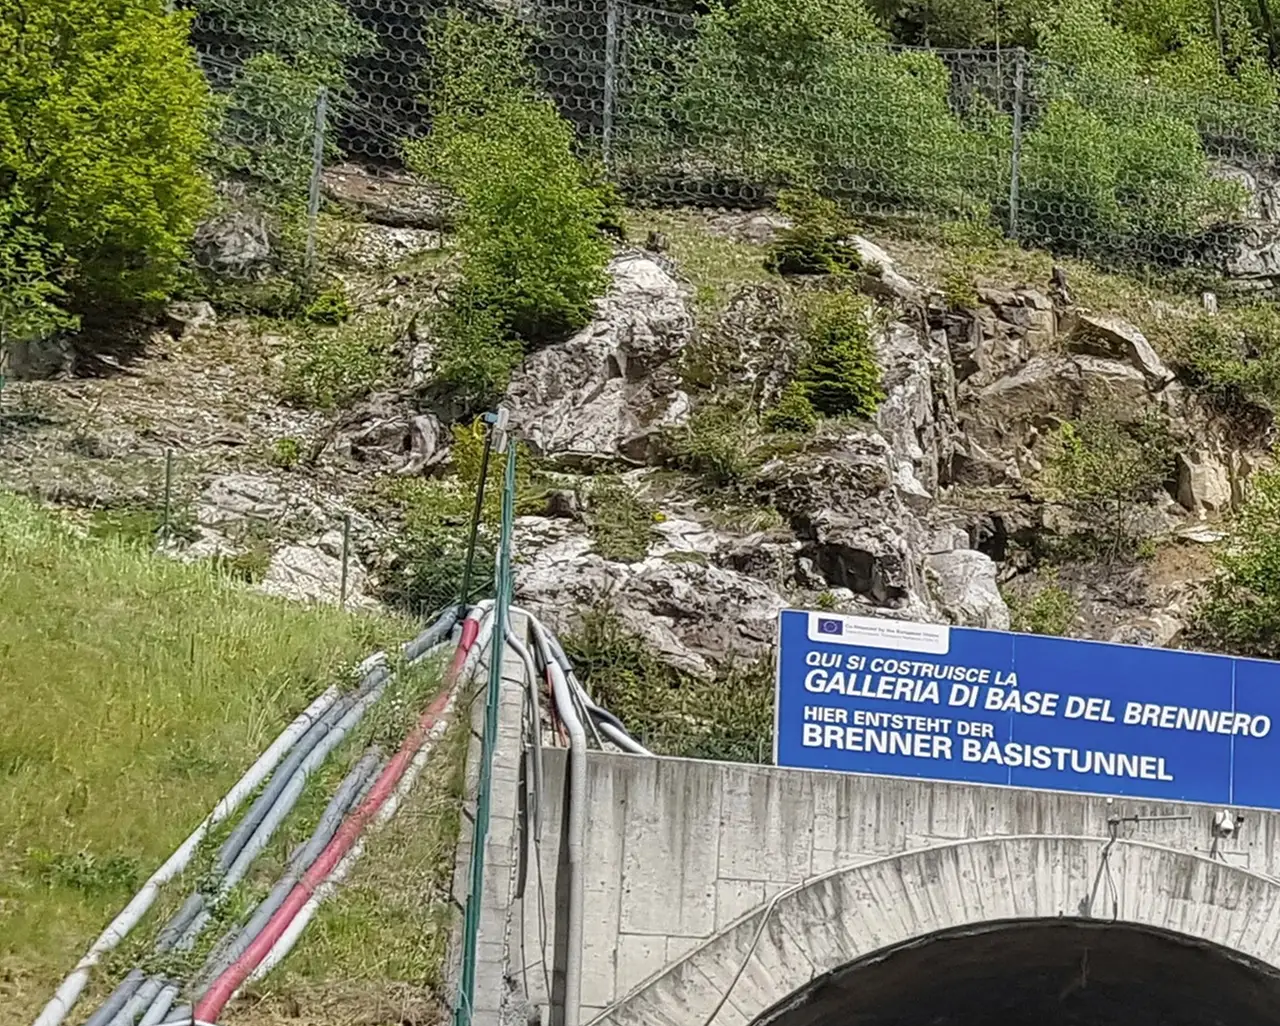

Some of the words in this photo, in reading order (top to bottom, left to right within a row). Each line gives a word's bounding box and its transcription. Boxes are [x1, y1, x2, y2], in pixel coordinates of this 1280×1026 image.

[805, 651, 842, 668] QUI
[846, 655, 866, 671] SI
[870, 658, 991, 683] COSTRUISCE
[994, 671, 1018, 687] LA
[804, 668, 940, 704] GALLERIA
[948, 683, 980, 708] DI
[984, 687, 1060, 716] BASE
[1064, 695, 1116, 723] DEL
[1123, 702, 1272, 738] BRENNERO
[804, 705, 848, 724] HIER
[853, 710, 952, 734] ENTSTEHT
[957, 720, 994, 739] DER
[802, 722, 953, 760] BRENNER
[962, 738, 1174, 781] BASISTUNNEL
